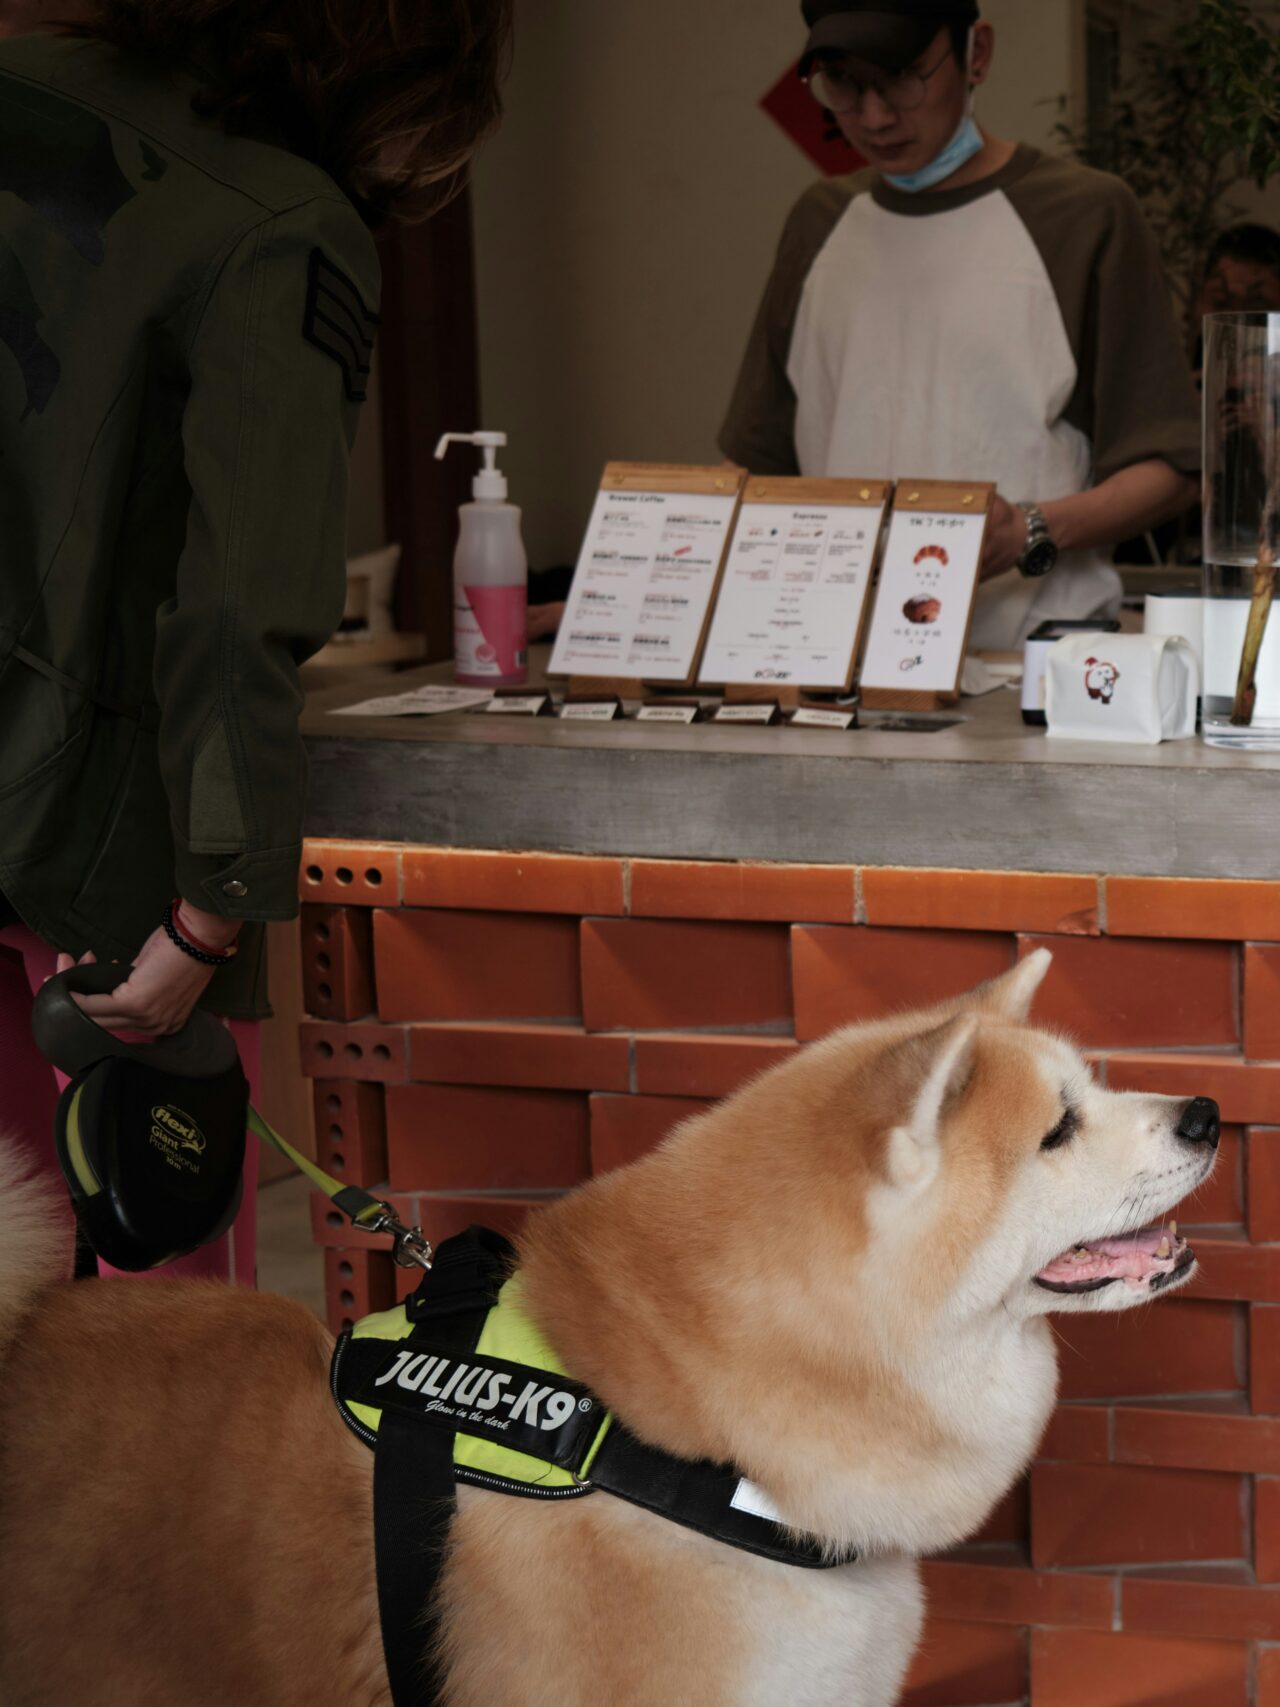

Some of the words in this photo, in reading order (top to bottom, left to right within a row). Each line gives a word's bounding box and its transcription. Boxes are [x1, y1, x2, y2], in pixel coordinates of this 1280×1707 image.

[640, 495, 665, 503] Coffee
[152, 1126, 179, 1150] Giant
[156, 1108, 196, 1139] flexi
[150, 1135, 200, 1175] Professional
[425, 1400, 455, 1413] Glows
[455, 1408, 467, 1418] in
[468, 1411, 484, 1423] the
[484, 1416, 512, 1430] dark
